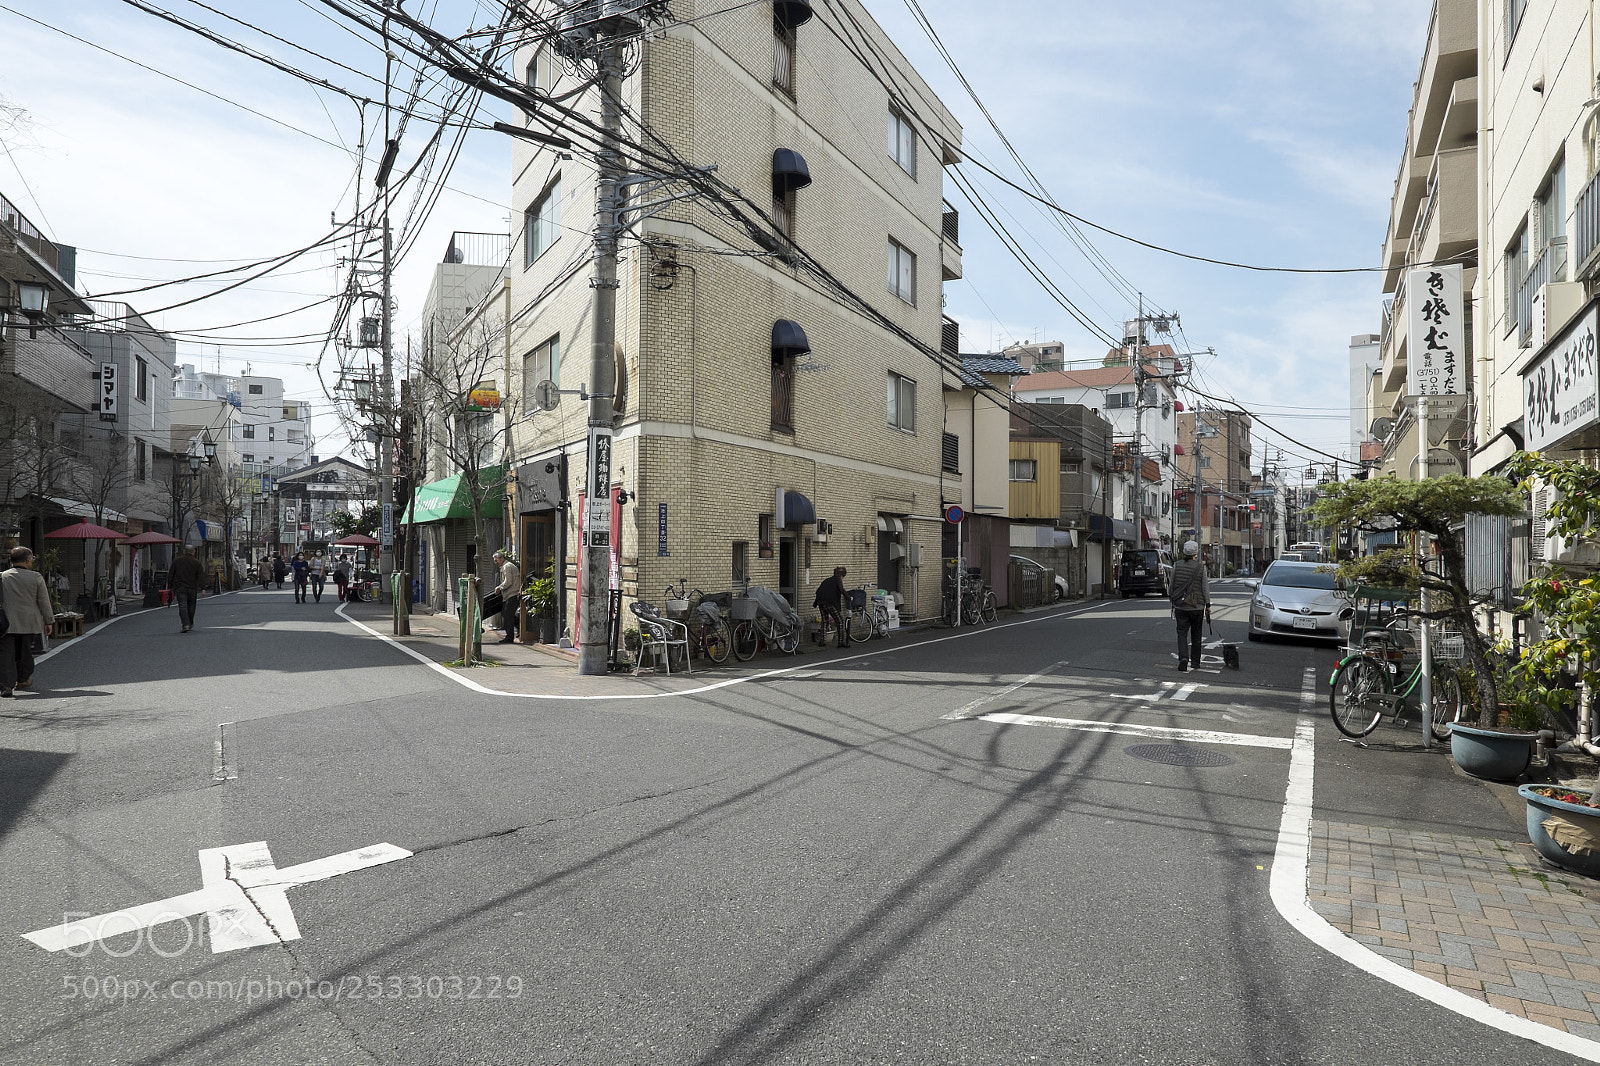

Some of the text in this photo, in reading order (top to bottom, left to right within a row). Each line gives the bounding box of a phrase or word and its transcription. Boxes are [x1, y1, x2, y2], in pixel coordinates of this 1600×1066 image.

[1416, 367, 1440, 377] (3751)
[1423, 352, 1433, 368] 電話
[1564, 326, 1594, 392] ますだや
[103, 365, 115, 411] シマヤ
